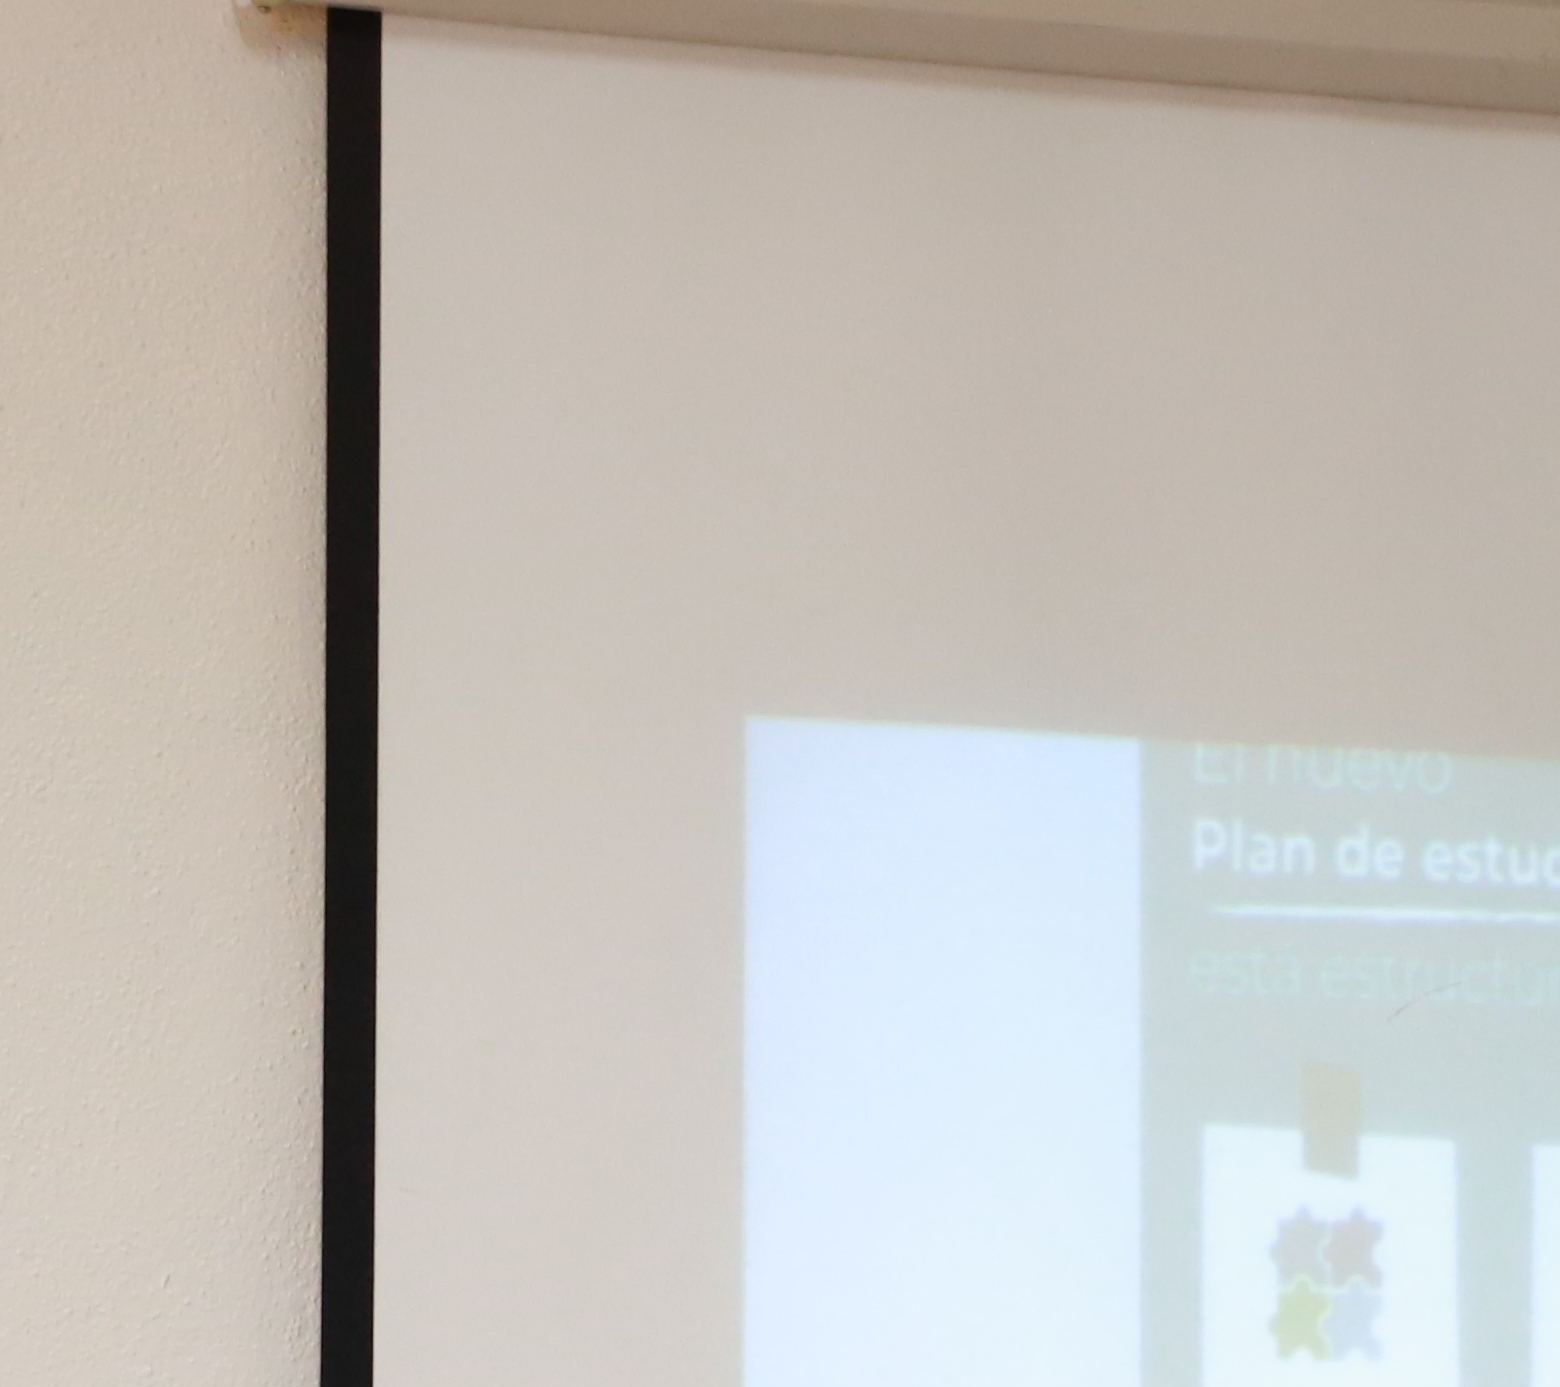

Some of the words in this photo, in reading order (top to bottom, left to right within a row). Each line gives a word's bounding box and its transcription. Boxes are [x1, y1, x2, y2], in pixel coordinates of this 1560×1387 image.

[1266, 745, 1454, 795] nuevo
[1192, 819, 1316, 876] Plan
[1335, 823, 1405, 880] de
